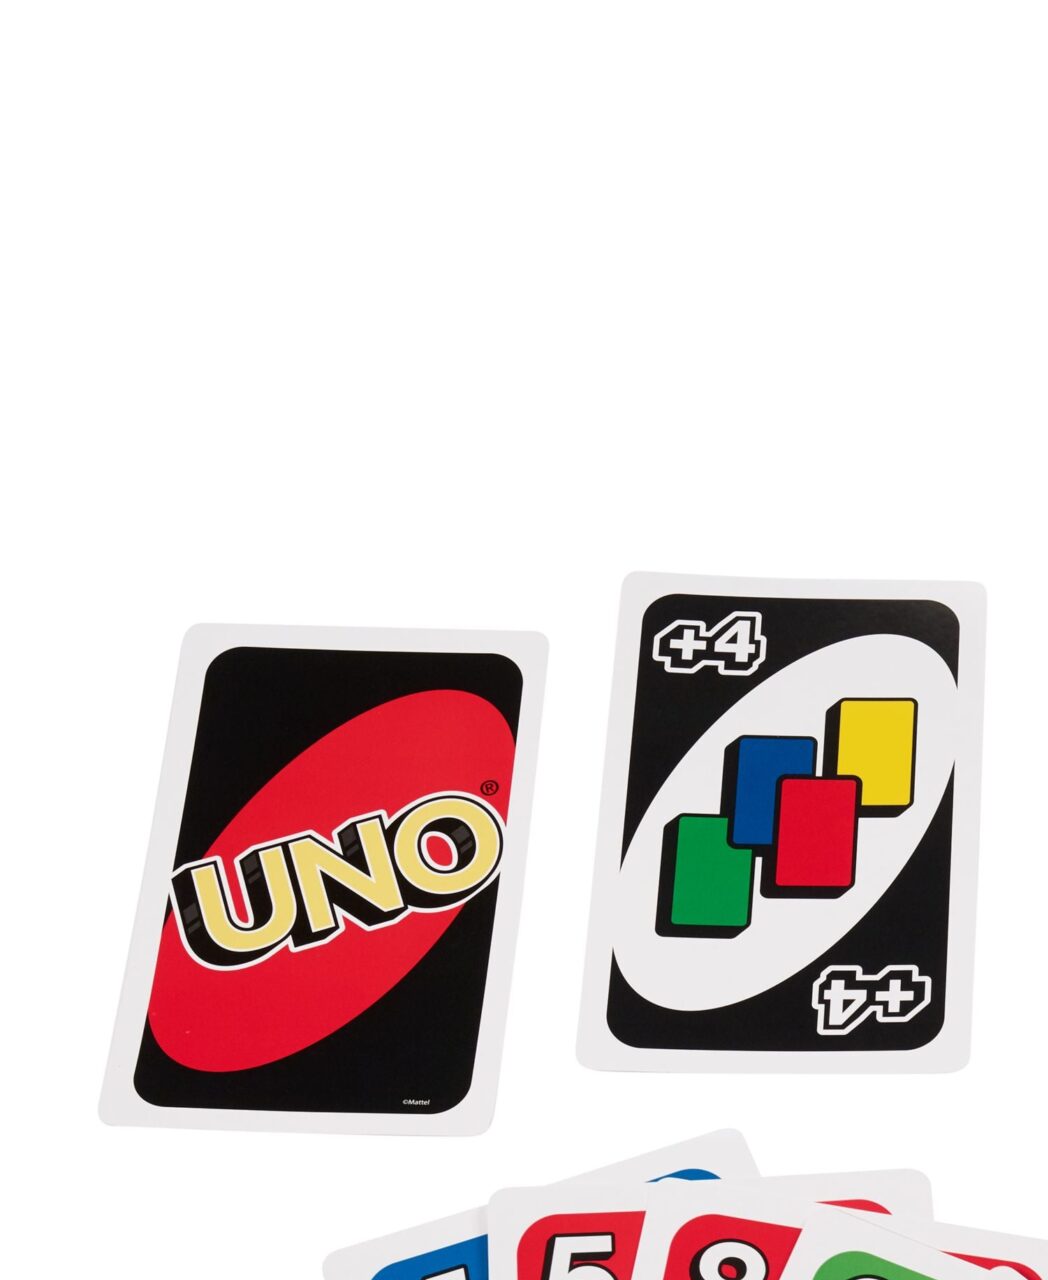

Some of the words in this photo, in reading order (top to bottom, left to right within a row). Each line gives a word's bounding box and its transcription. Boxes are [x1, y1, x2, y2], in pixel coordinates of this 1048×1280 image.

[660, 615, 761, 669] +4
[175, 793, 504, 966] UNO
[817, 970, 923, 1031] +4
